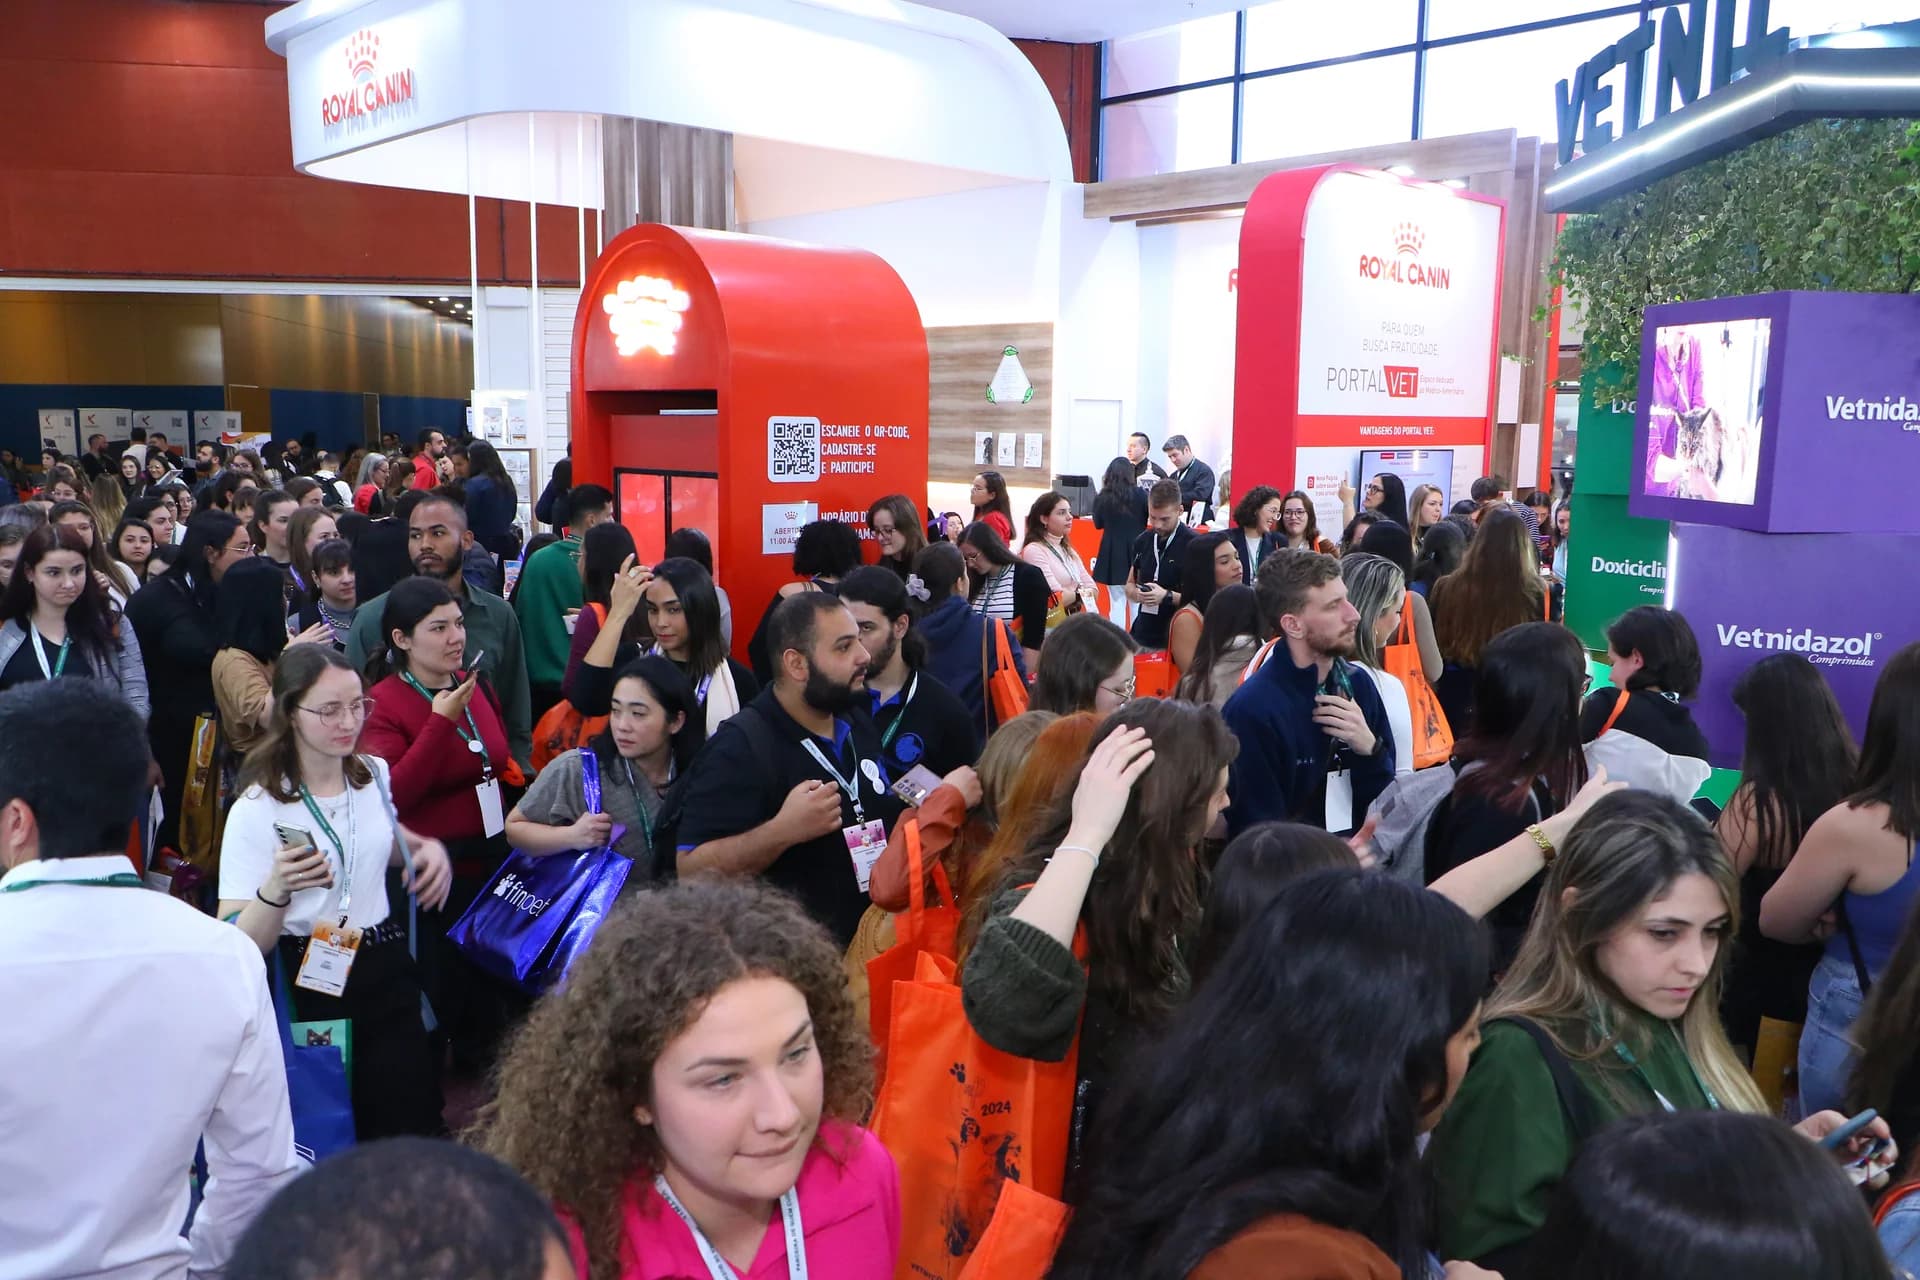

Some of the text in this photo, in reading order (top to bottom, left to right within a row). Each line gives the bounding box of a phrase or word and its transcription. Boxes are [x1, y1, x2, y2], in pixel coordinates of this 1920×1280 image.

[1555, 0, 1790, 165] VETNIL
[322, 67, 411, 127] ROYAL CANIN
[1360, 254, 1450, 290] ROYAL CANIN
[1382, 321, 1425, 337] PARA QUEM
[1327, 367, 1418, 397] PORTAL VET
[821, 425, 910, 439] ESCANEIE O QR-CODE,
[1360, 426, 1393, 436] VANTAGENS
[1402, 426, 1422, 436] PORTAL
[821, 443, 876, 455] CADASTRE-SE
[821, 461, 875, 473] E PARTICIPE!
[1808, 653, 1875, 667] Comprimidos
[981, 1100, 1011, 1117] 2024
